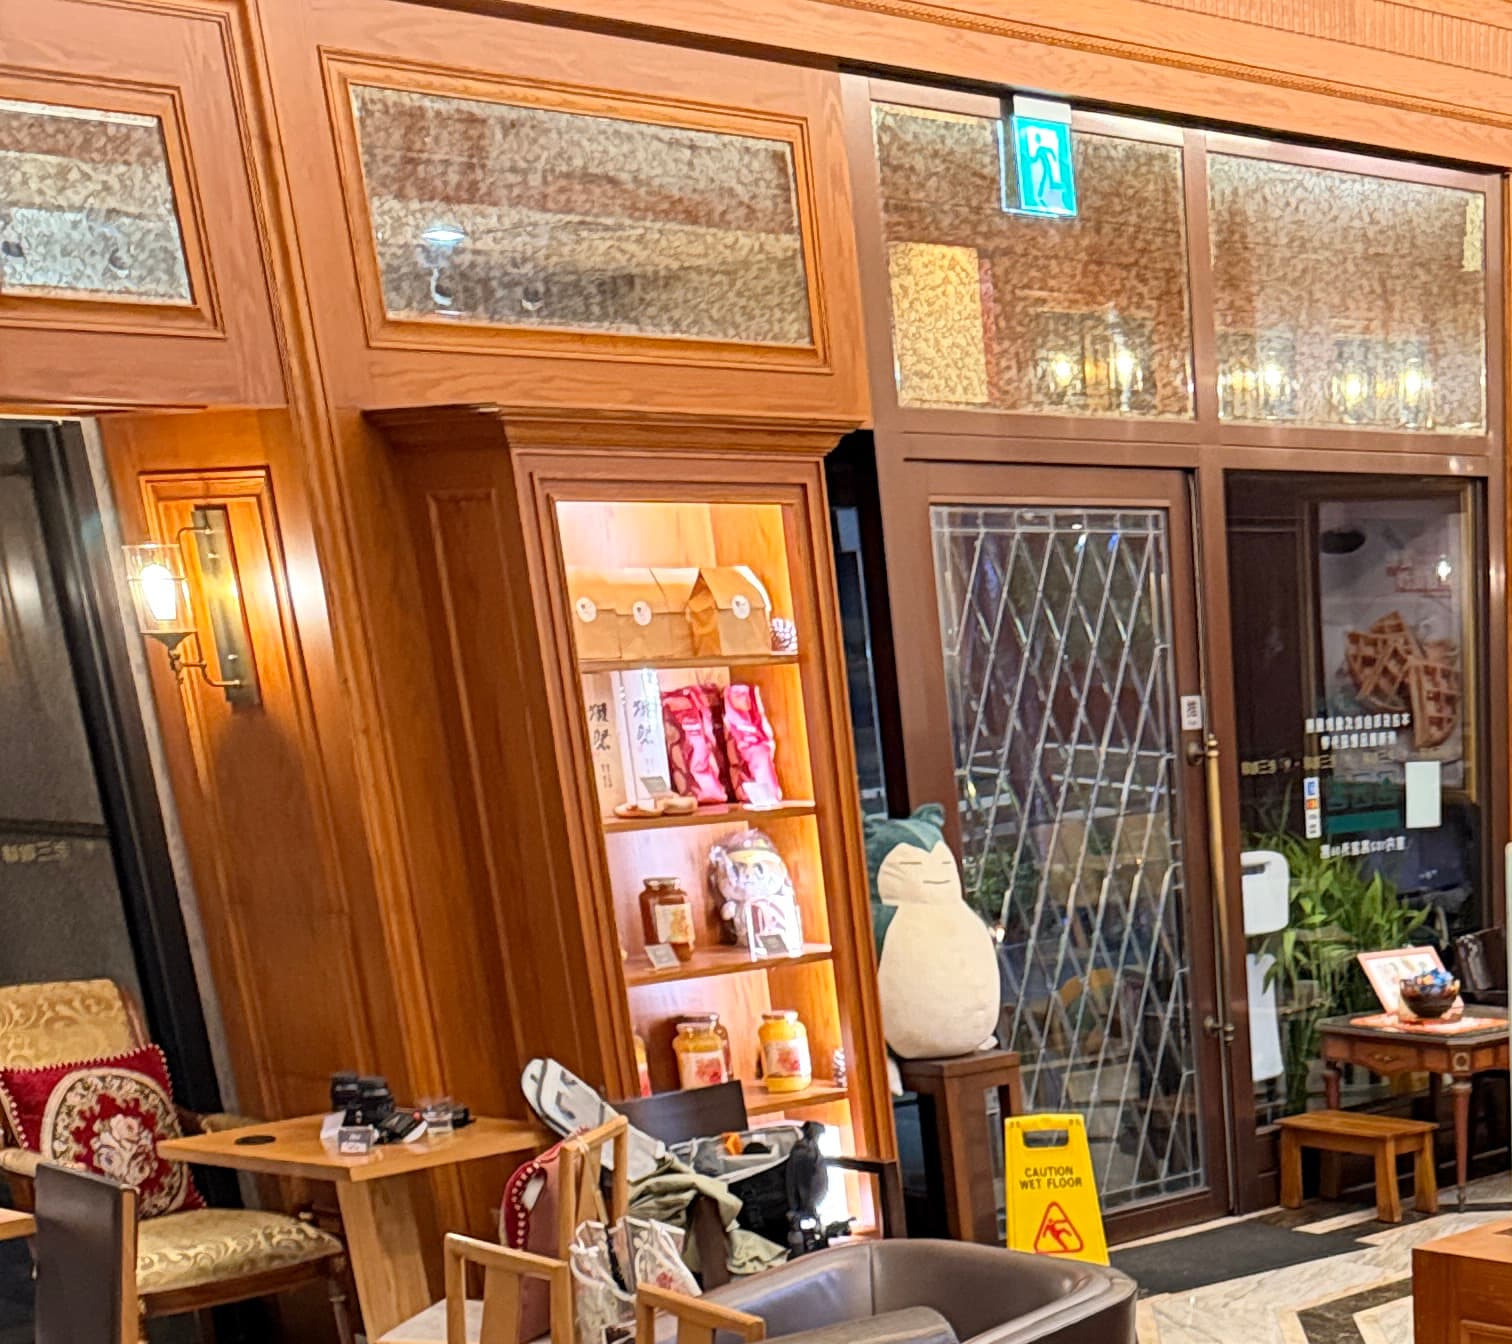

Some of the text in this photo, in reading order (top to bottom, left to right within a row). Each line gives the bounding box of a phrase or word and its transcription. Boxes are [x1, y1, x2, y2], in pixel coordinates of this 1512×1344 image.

[1024, 1165, 1074, 1178] CAUTION
[1019, 1176, 1082, 1190] WET FLOOR
